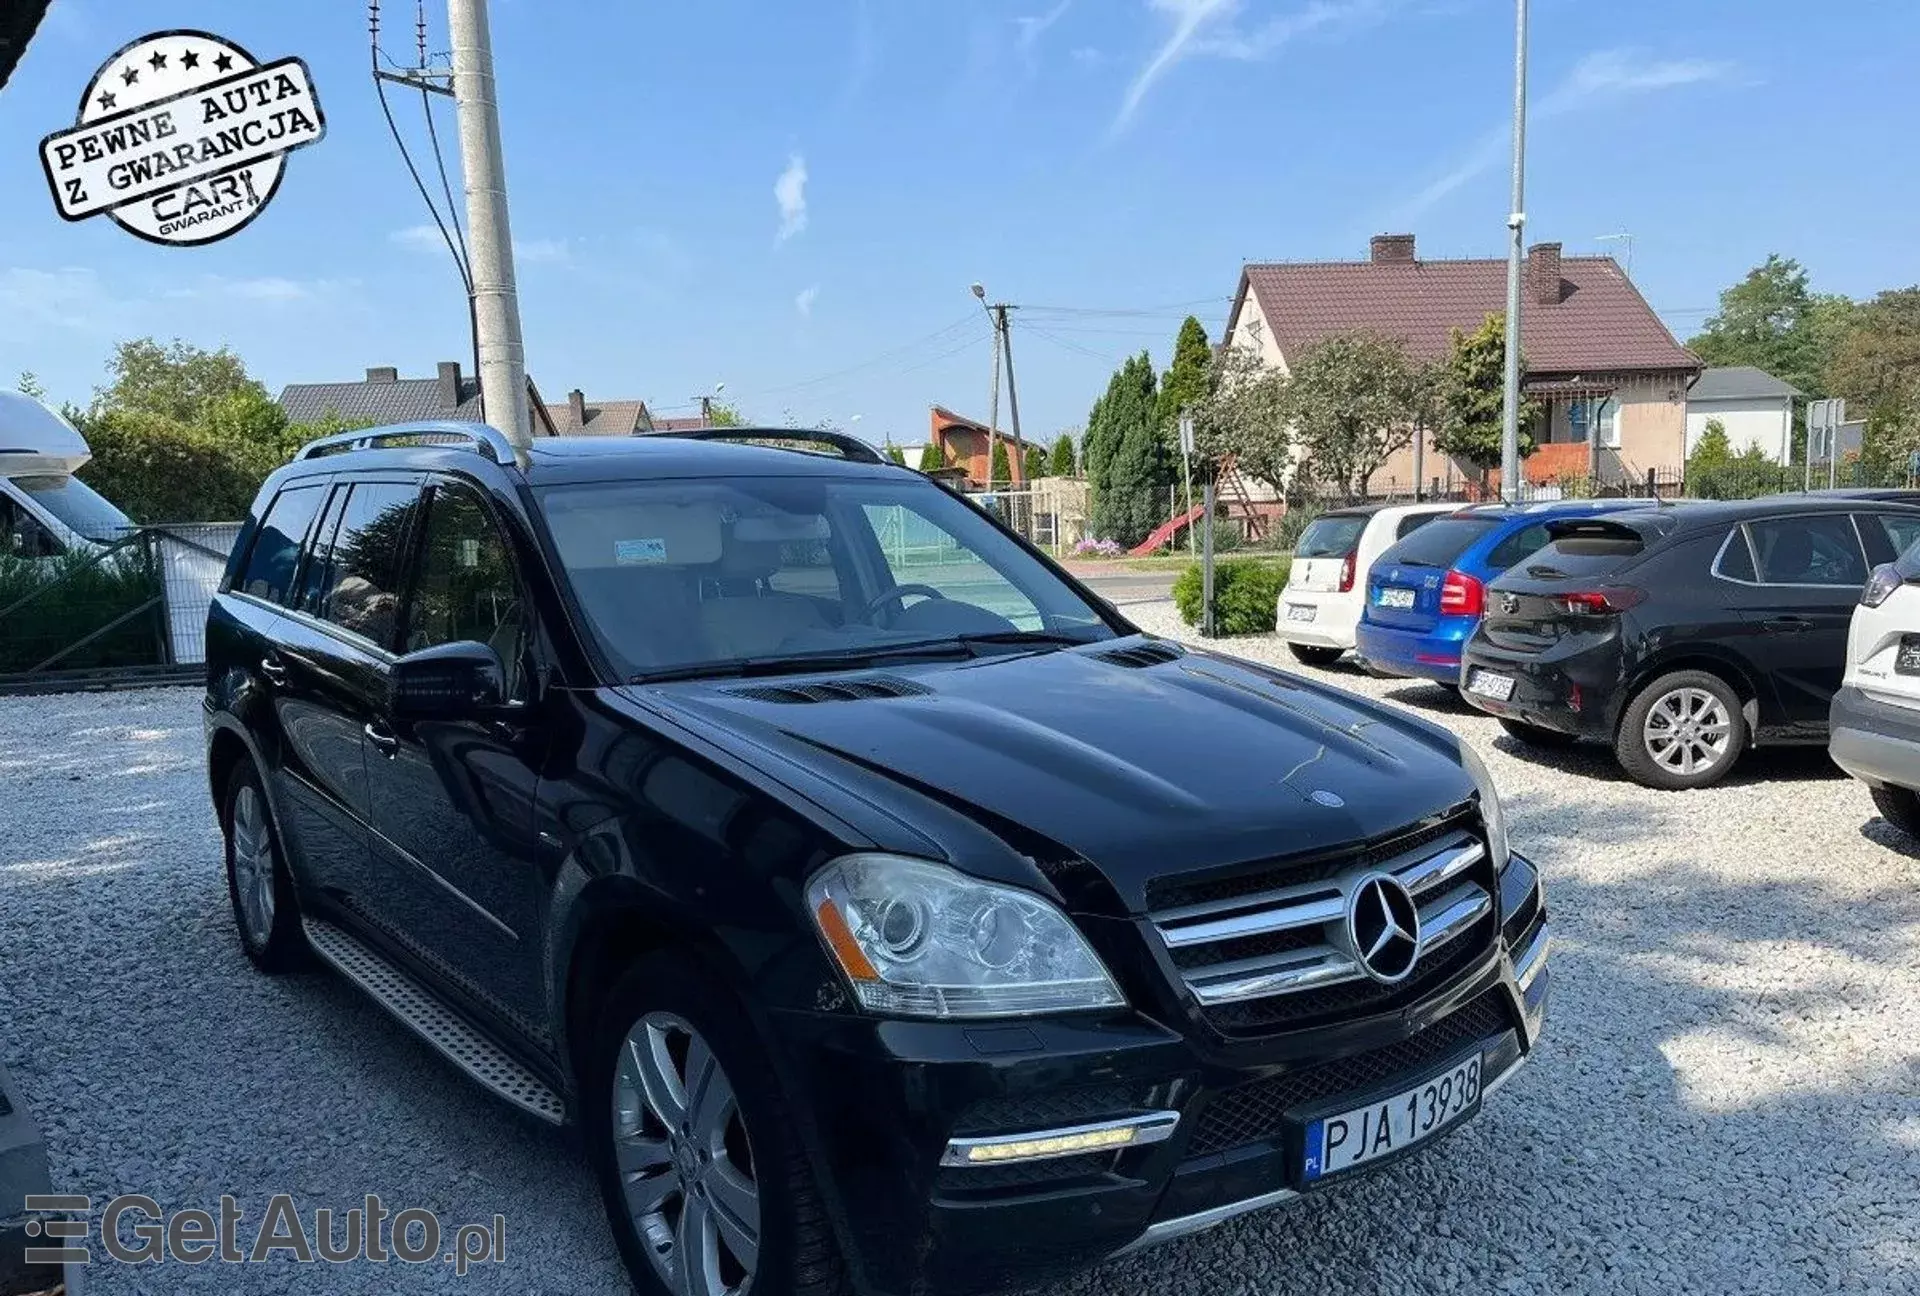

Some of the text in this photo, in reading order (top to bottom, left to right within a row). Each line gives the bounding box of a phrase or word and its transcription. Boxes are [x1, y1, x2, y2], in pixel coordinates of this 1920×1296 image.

[1325, 1060, 1479, 1169] PJA 13938
[1305, 1157, 1319, 1171] PL
